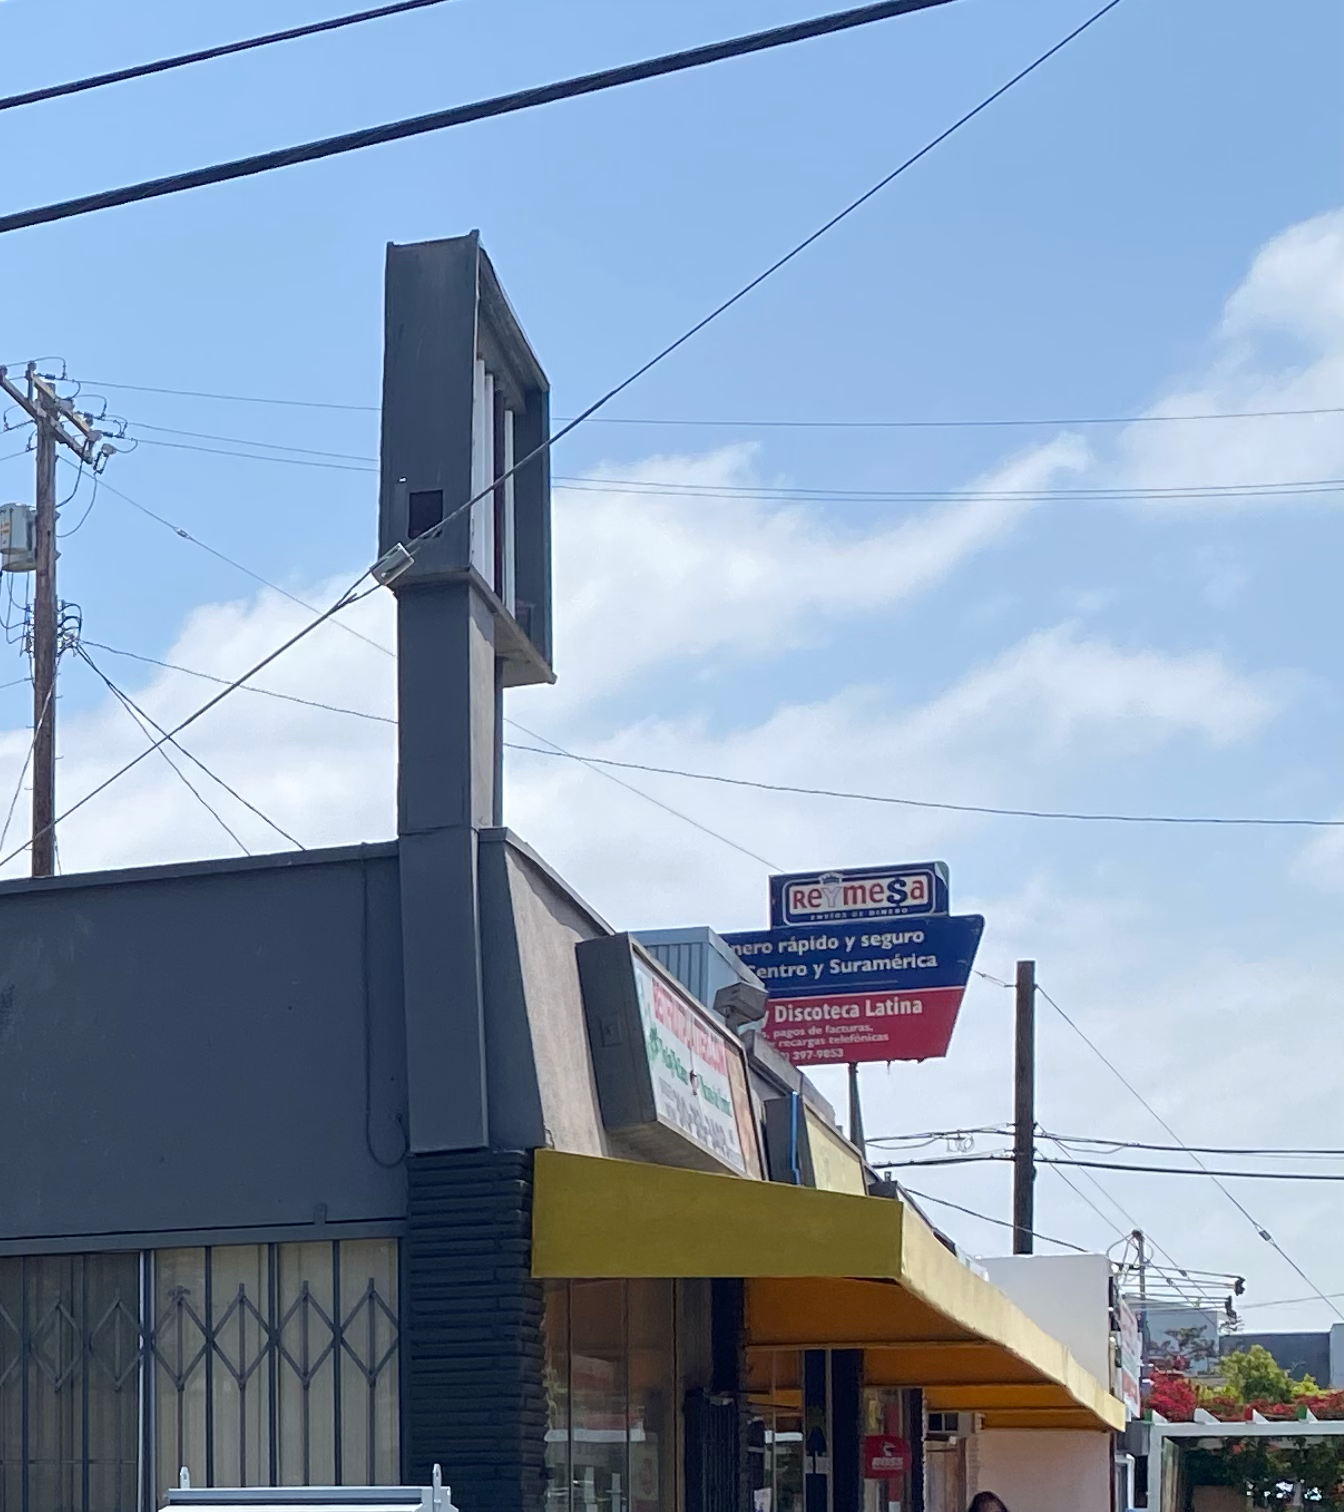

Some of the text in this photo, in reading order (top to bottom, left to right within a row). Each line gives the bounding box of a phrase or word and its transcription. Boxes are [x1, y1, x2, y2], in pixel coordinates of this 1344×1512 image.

[778, 935, 839, 956] rápido
[845, 935, 856, 953] y
[861, 930, 925, 949] seguro
[813, 962, 824, 980] y
[829, 953, 938, 975] Suramérica
[774, 1003, 860, 1023] Discoteca
[865, 996, 924, 1017] Latina
[773, 1028, 806, 1039] pagos
[808, 1025, 823, 1036] de
[778, 1036, 826, 1048] recargas
